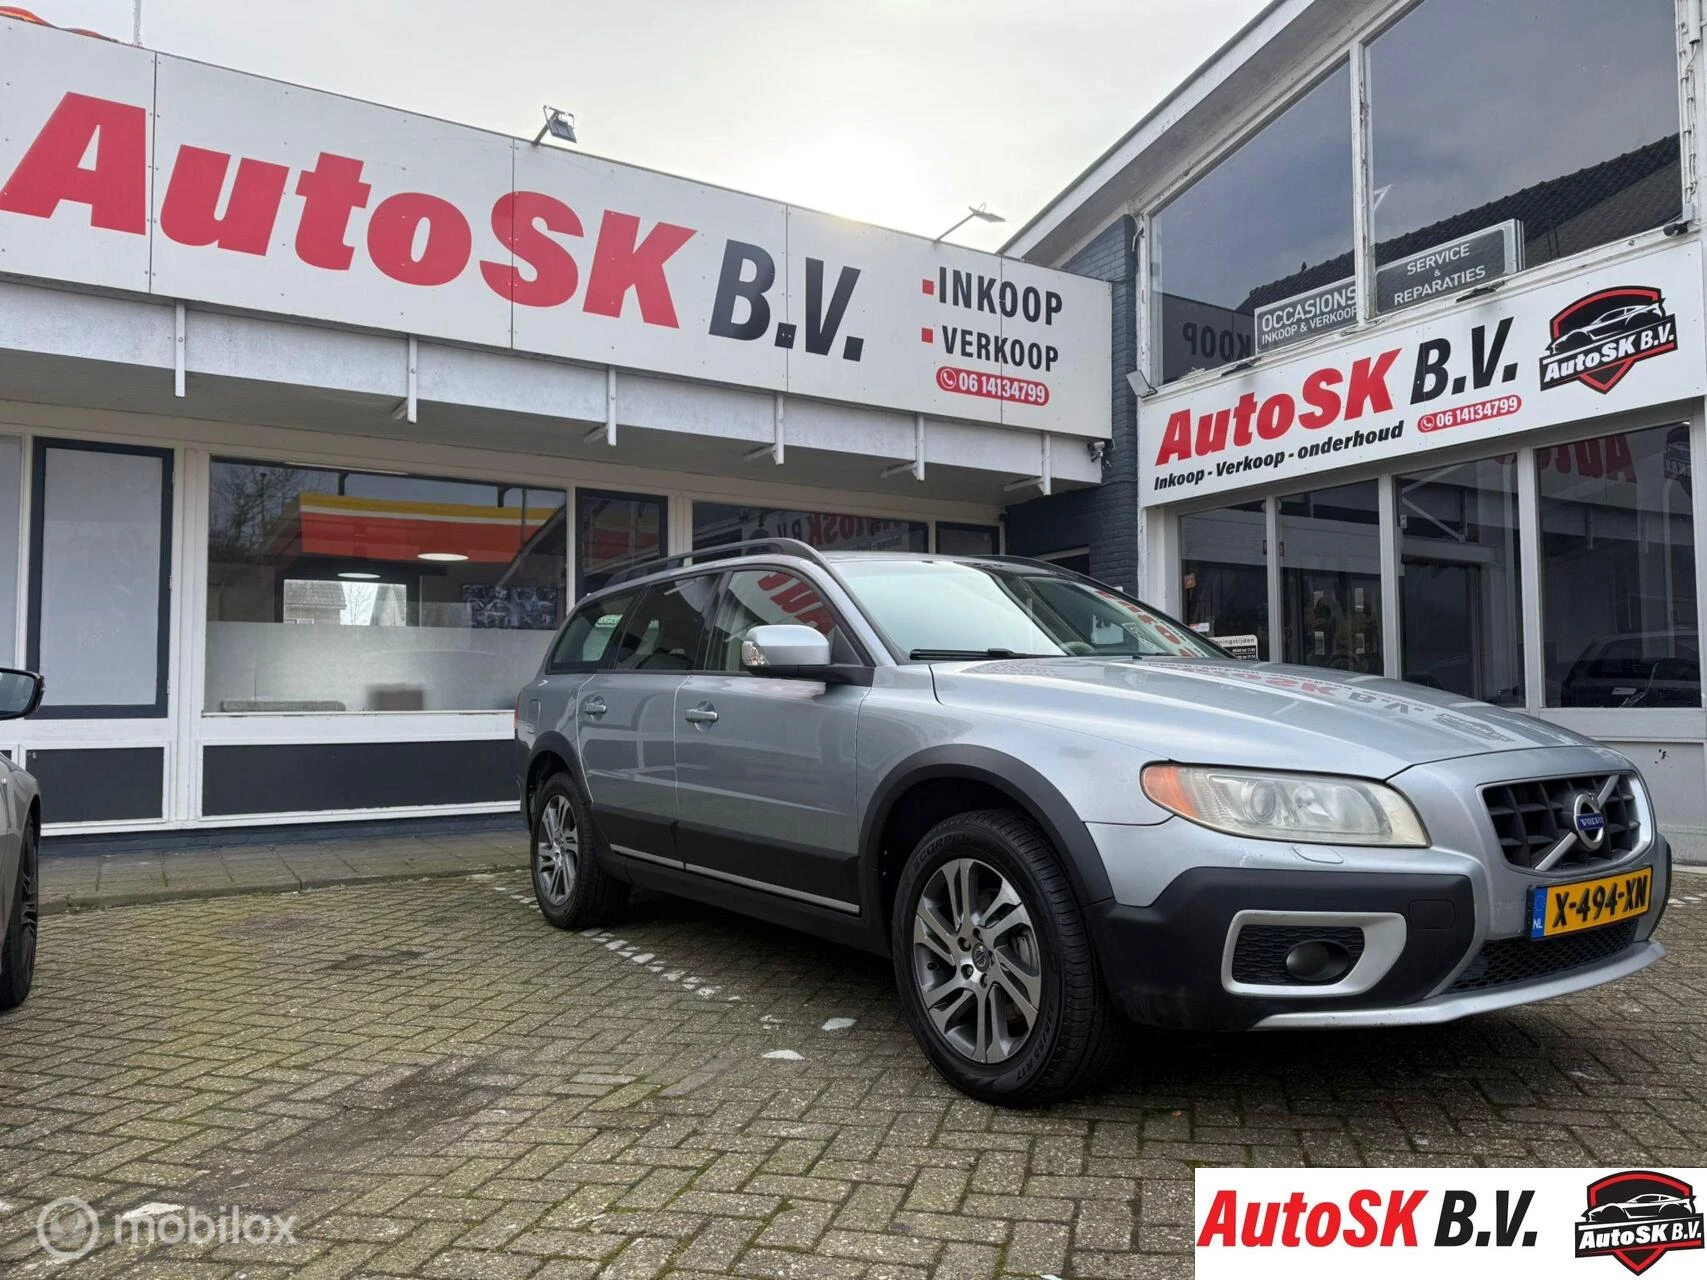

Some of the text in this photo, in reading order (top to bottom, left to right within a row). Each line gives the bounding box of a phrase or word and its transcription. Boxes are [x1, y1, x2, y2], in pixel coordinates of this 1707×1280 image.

[0, 91, 864, 362] AutoSK B.V.
[1407, 243, 1470, 275] SERVICE
[1434, 269, 1440, 277] &
[939, 266, 1062, 326] INKOOP
[1394, 265, 1486, 305] REPARATIES
[1262, 286, 1357, 332] OCCASIONS
[942, 325, 1058, 372] VERKOOP
[1262, 324, 1297, 345] INKOOP
[1300, 322, 1307, 332] &
[1544, 321, 1675, 383] AutoSK B.V.
[959, 372, 1045, 403] 06 14134799
[1155, 317, 1518, 467] AutoSK B.V.
[1436, 397, 1518, 428] 06 14134799
[1154, 469, 1205, 490] Inkoop
[1215, 450, 1285, 477] Verkoop
[1298, 420, 1404, 459] onderhoud
[1580, 816, 1603, 826] VOLVO
[1552, 875, 1649, 928] X-494-XN
[1533, 919, 1543, 929] NL
